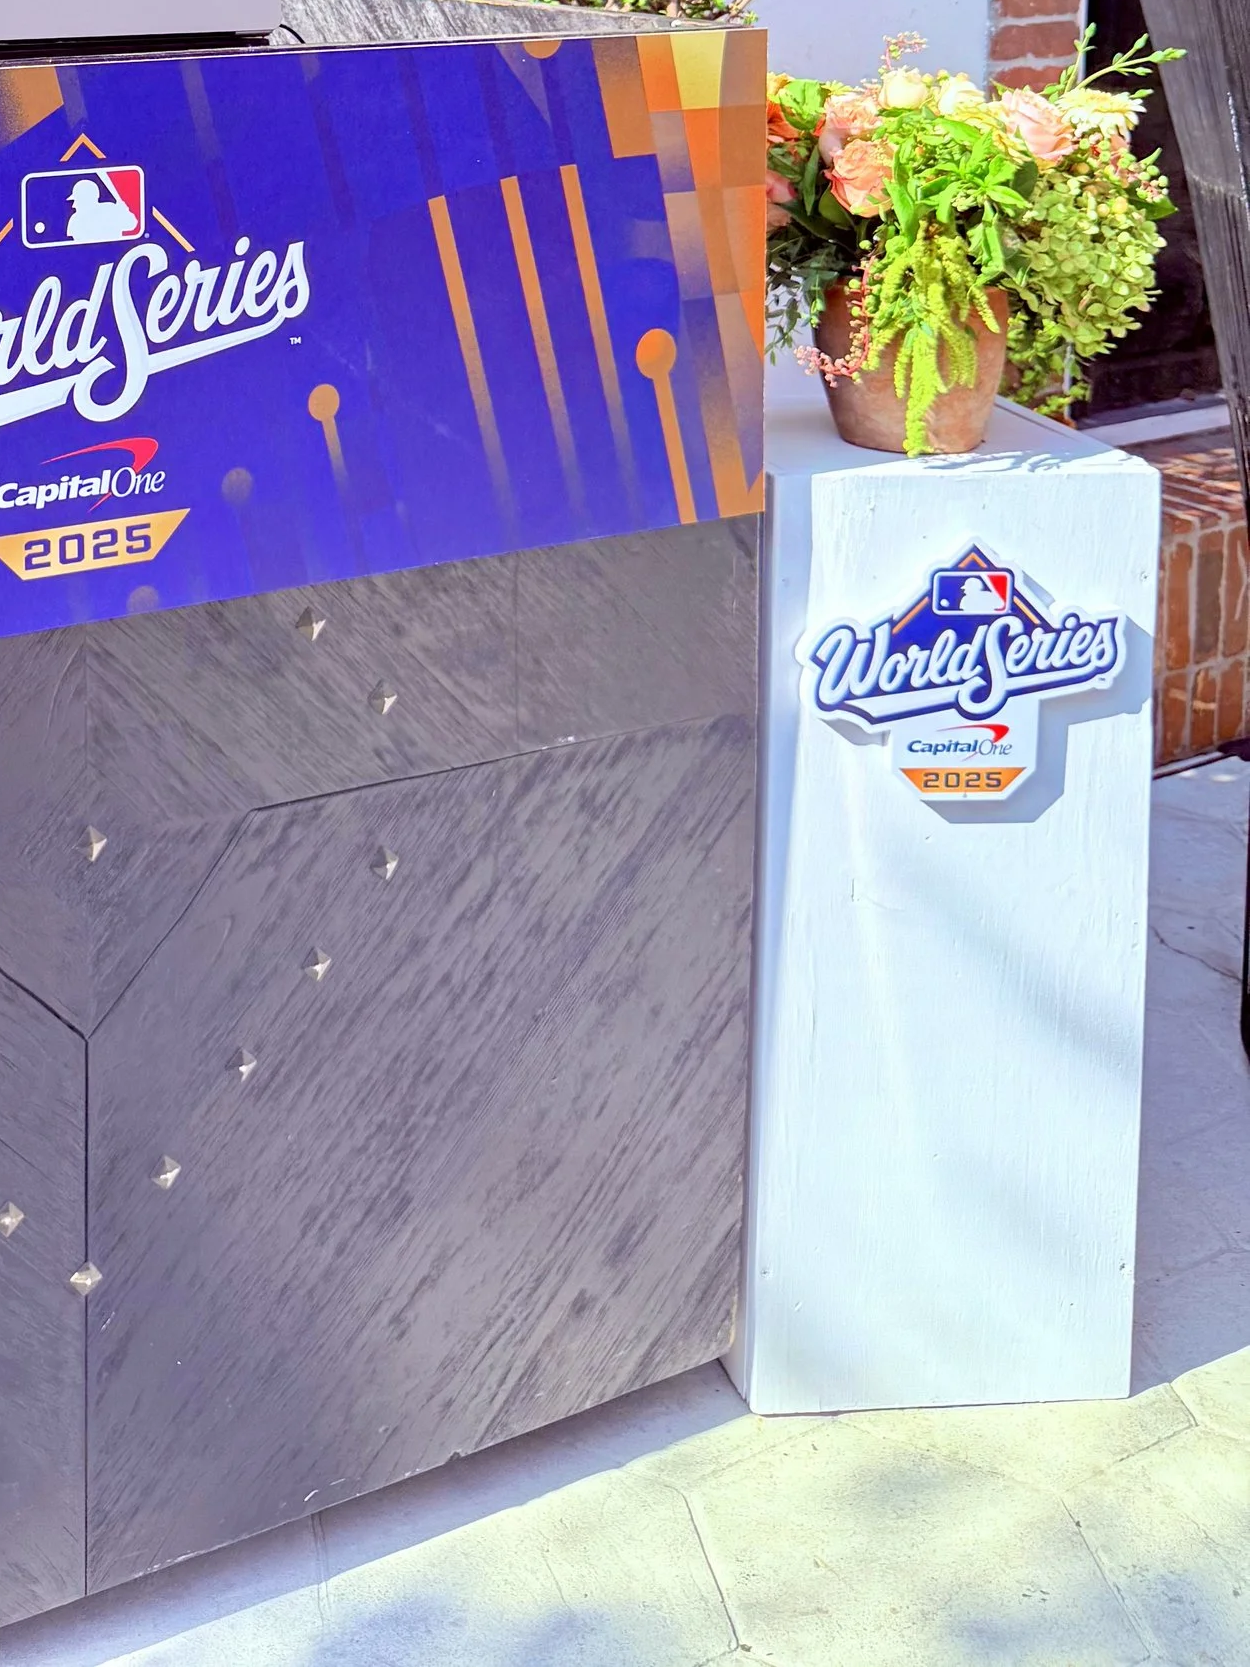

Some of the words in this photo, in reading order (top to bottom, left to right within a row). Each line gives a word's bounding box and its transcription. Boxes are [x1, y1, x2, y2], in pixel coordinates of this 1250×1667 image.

[73, 236, 311, 422] Series
[24, 523, 152, 571] 2025
[816, 621, 988, 706] World
[957, 614, 1119, 715] Series
[922, 772, 1002, 789] 2025
